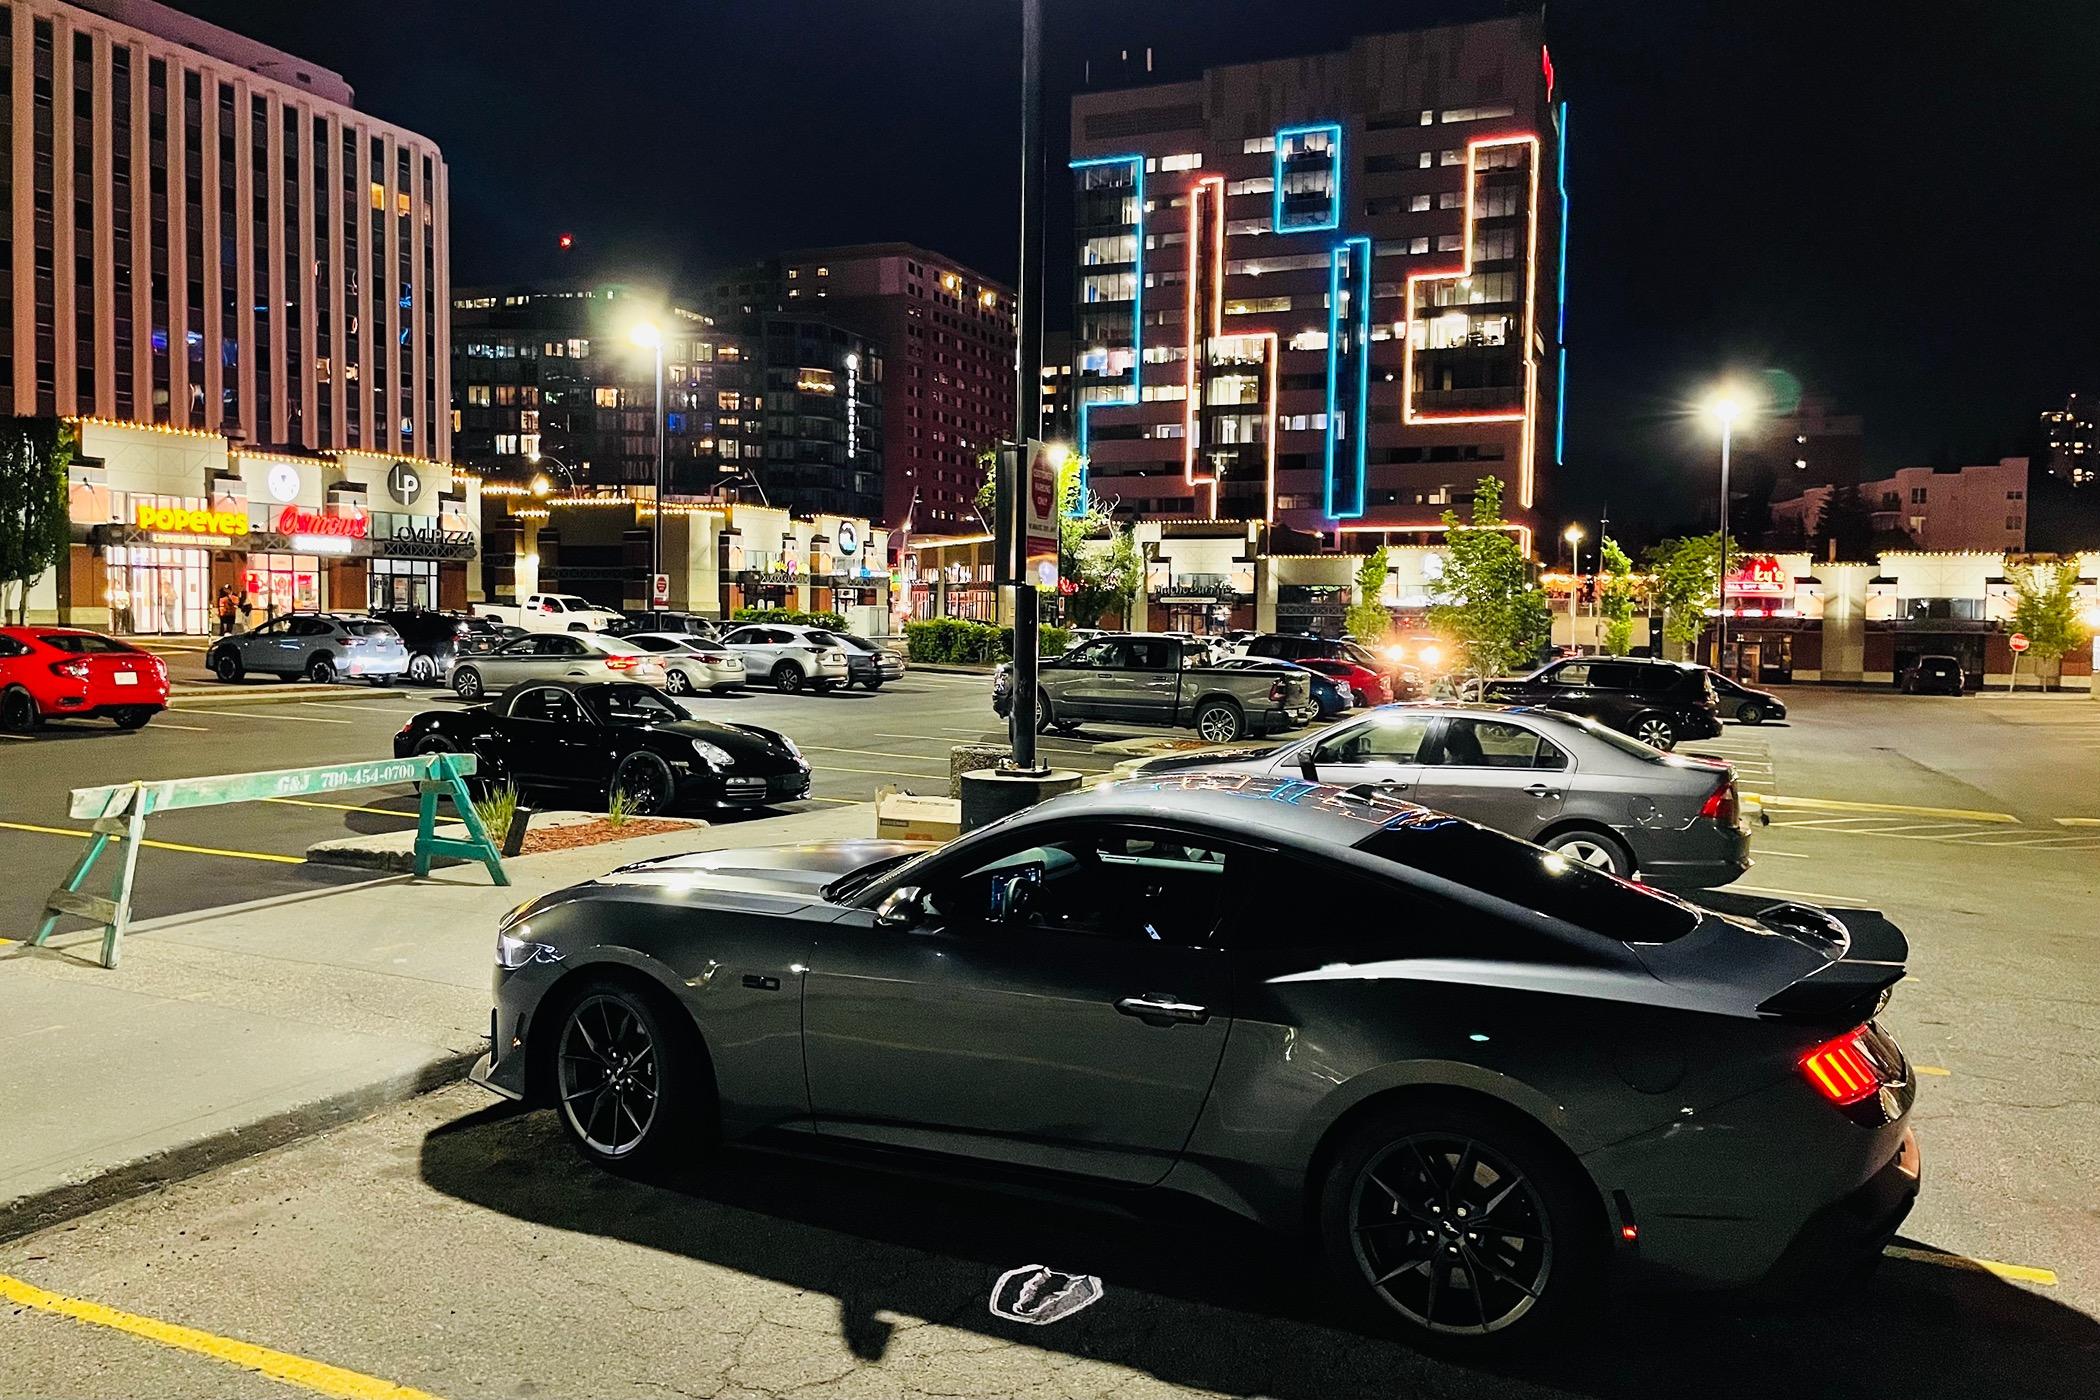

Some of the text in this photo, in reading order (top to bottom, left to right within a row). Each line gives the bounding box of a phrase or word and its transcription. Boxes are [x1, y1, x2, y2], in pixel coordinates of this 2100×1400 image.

[396, 466, 419, 506] LP
[276, 764, 415, 793] G&J 780-454-0700
